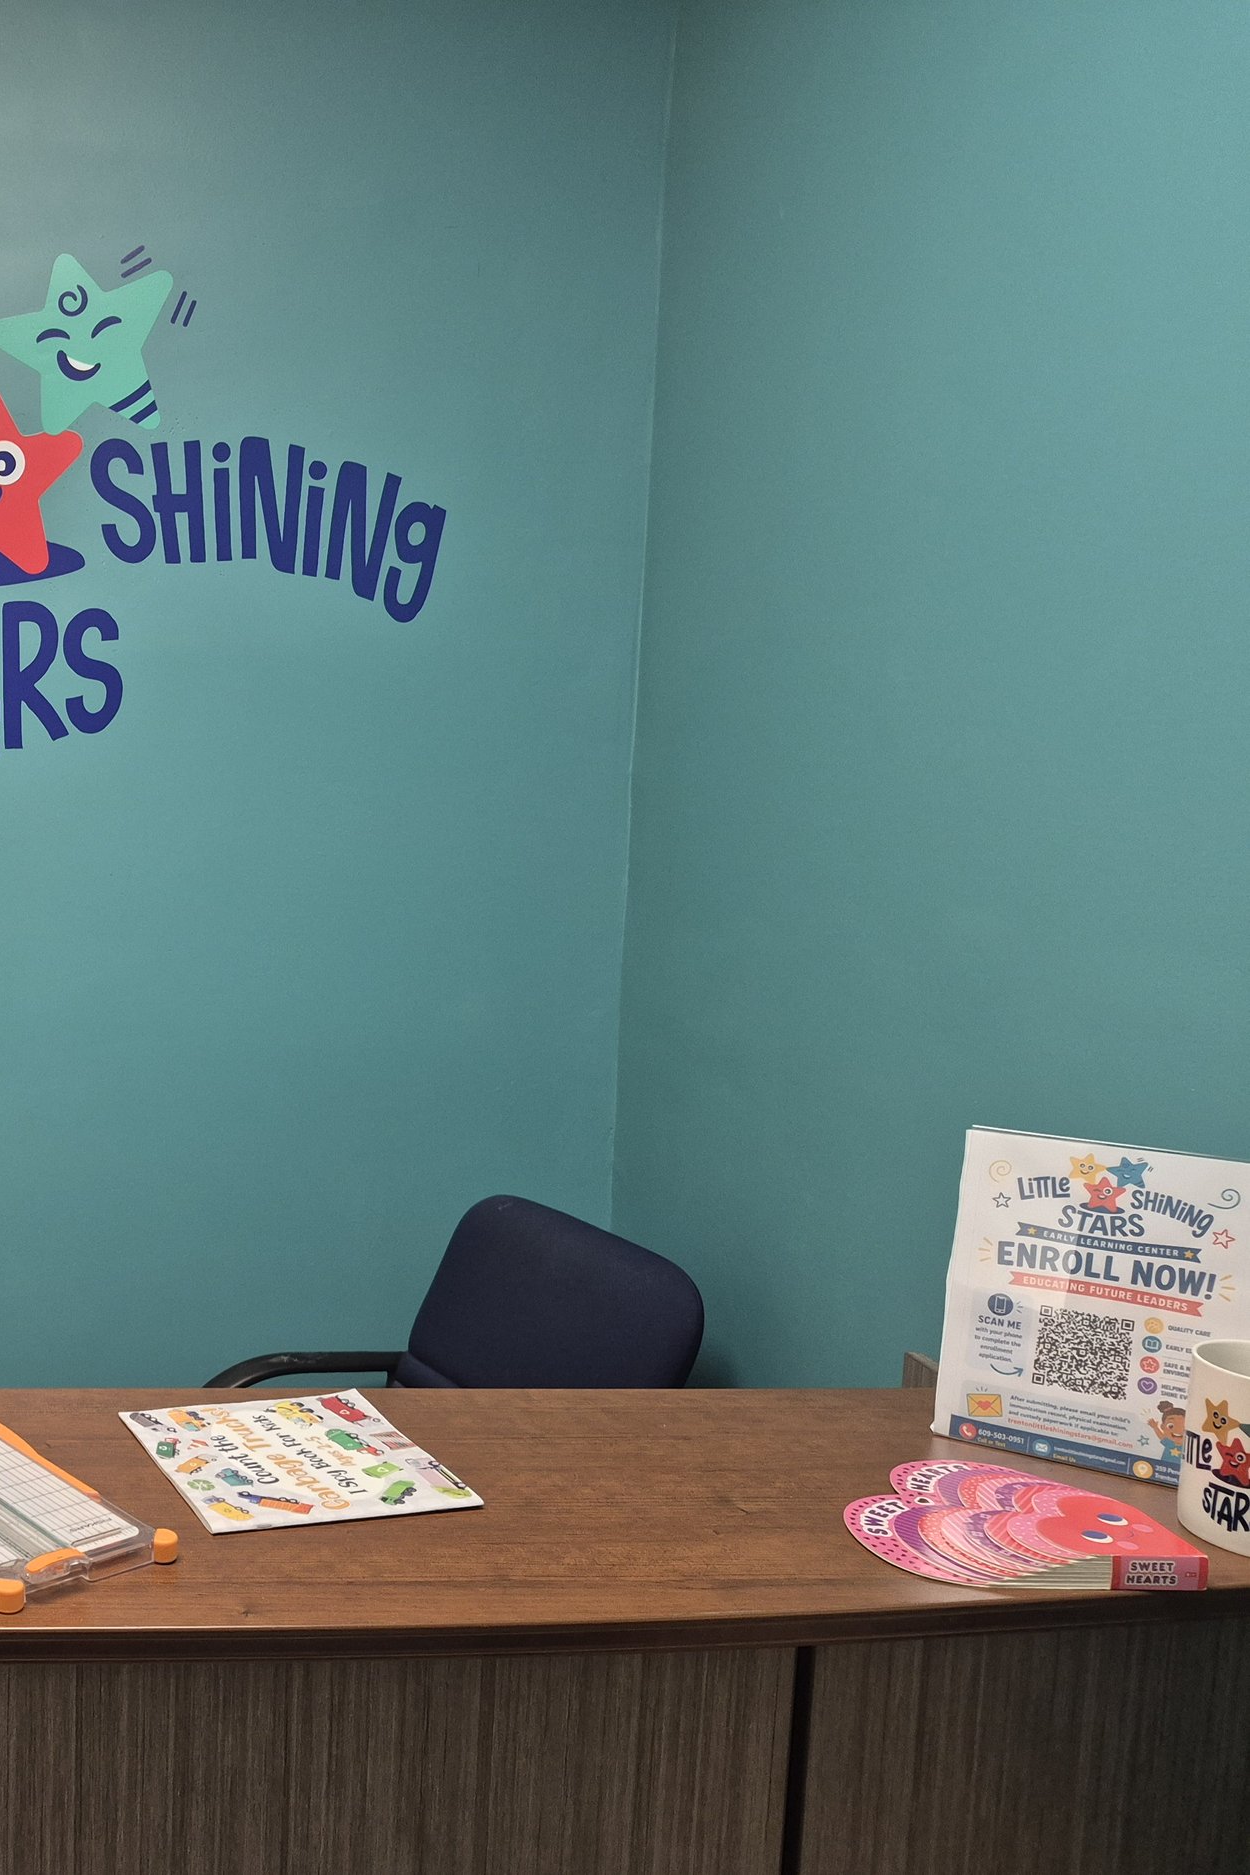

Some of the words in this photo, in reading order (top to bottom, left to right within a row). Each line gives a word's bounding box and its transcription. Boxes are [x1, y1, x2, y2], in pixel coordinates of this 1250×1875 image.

[1057, 1205, 1145, 1237] STARS
[1043, 1230, 1077, 1243] EARLY
[1080, 1237, 1134, 1252] LEARNING
[1137, 1245, 1180, 1257] CENTER
[997, 1240, 1120, 1282] ENROLL
[1130, 1259, 1217, 1300] NOW!
[1022, 1275, 1086, 1293] EDUCATING
[1089, 1285, 1133, 1301] FUTURE
[1136, 1294, 1189, 1312] LEADERS
[978, 1315, 1005, 1327] SCAN
[1007, 1320, 1022, 1330] ME
[1167, 1324, 1194, 1335] QUALITY
[1195, 1329, 1212, 1337] CARE
[980, 1345, 1013, 1354] enrollment
[982, 1336, 1010, 1345] complete
[1165, 1344, 1184, 1352] EARLY
[1164, 1361, 1179, 1369] SAFE
[1161, 1384, 1187, 1393] HELPING
[1009, 1395, 1025, 1403] After
[1026, 1399, 1058, 1410] submitting,
[1059, 1405, 1078, 1413] please
[1111, 1416, 1131, 1424] child's
[1009, 1402, 1047, 1414] immunization
[1068, 1414, 1093, 1425] physical
[1042, 1416, 1073, 1427] paperwork
[1080, 1424, 1110, 1436] applicable
[210, 1434, 239, 1453] the
[978, 1428, 1025, 1445] 609-503-0951
[995, 1440, 1007, 1448] Text
[295, 1447, 332, 1470] Book
[328, 1449, 357, 1467] Ages
[1053, 1453, 1068, 1461] Email
[229, 1452, 280, 1485] Count
[266, 1453, 351, 1510] Garbage
[327, 1469, 359, 1489] Spy
[349, 1487, 369, 1495] I
[863, 1501, 906, 1536] SWEET
[910, 1464, 968, 1492] HEARTS
[1202, 1481, 1250, 1532] STAR
[1130, 1561, 1174, 1571] SWEET
[1126, 1575, 1177, 1584] HEARTS
